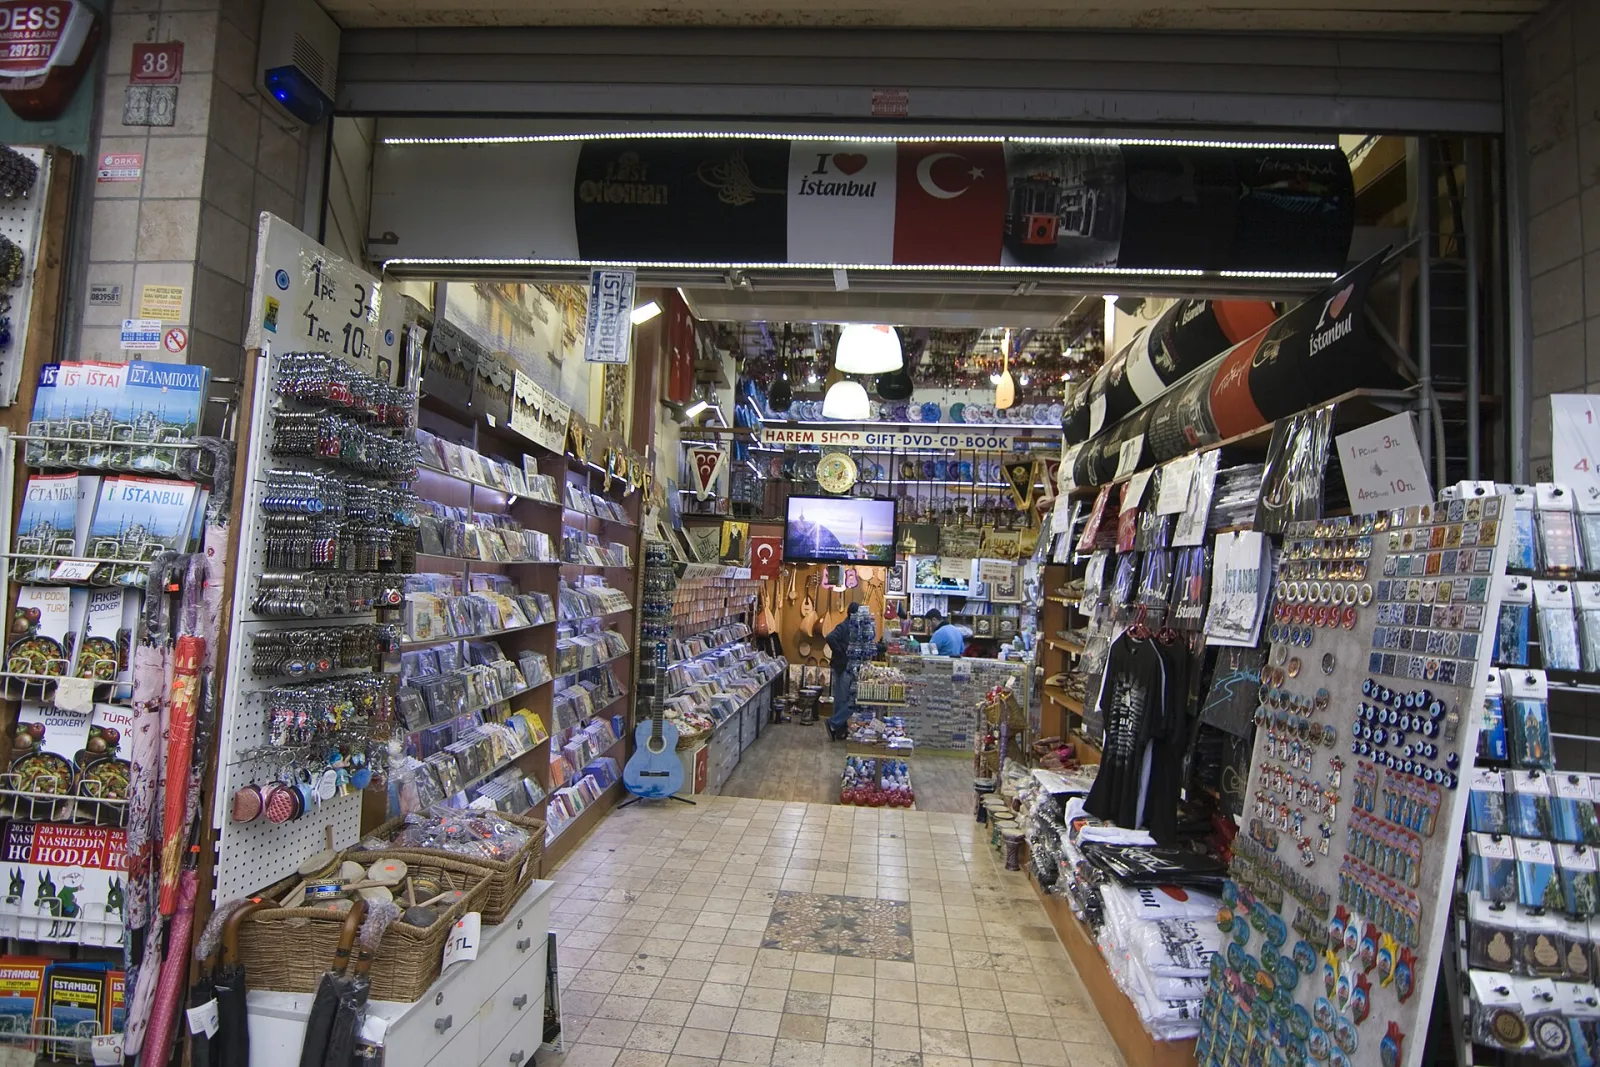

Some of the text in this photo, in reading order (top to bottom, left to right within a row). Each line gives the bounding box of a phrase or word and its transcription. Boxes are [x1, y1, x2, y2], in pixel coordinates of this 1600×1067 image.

[9, 44, 27, 57] 297
[27, 44, 40, 57] 23
[142, 53, 168, 73] 38
[114, 158, 138, 166] ORKA
[798, 153, 877, 198] I İstanbul
[1584, 410, 1593, 425] 1
[766, 430, 815, 443] HAREM
[821, 432, 860, 443] SHOP
[1573, 458, 1590, 473] 4
[122, 486, 185, 506] ISTANBUL
[45, 718, 86, 728] COOKERY
[11, 824, 23, 832] 202
[40, 826, 107, 838] 202 WITZE VON
[111, 831, 124, 839] 202
[37, 847, 100, 866] HODJA
[0, 969, 40, 979] ISTANBUL
[54, 981, 98, 992] ESTAMBUL
